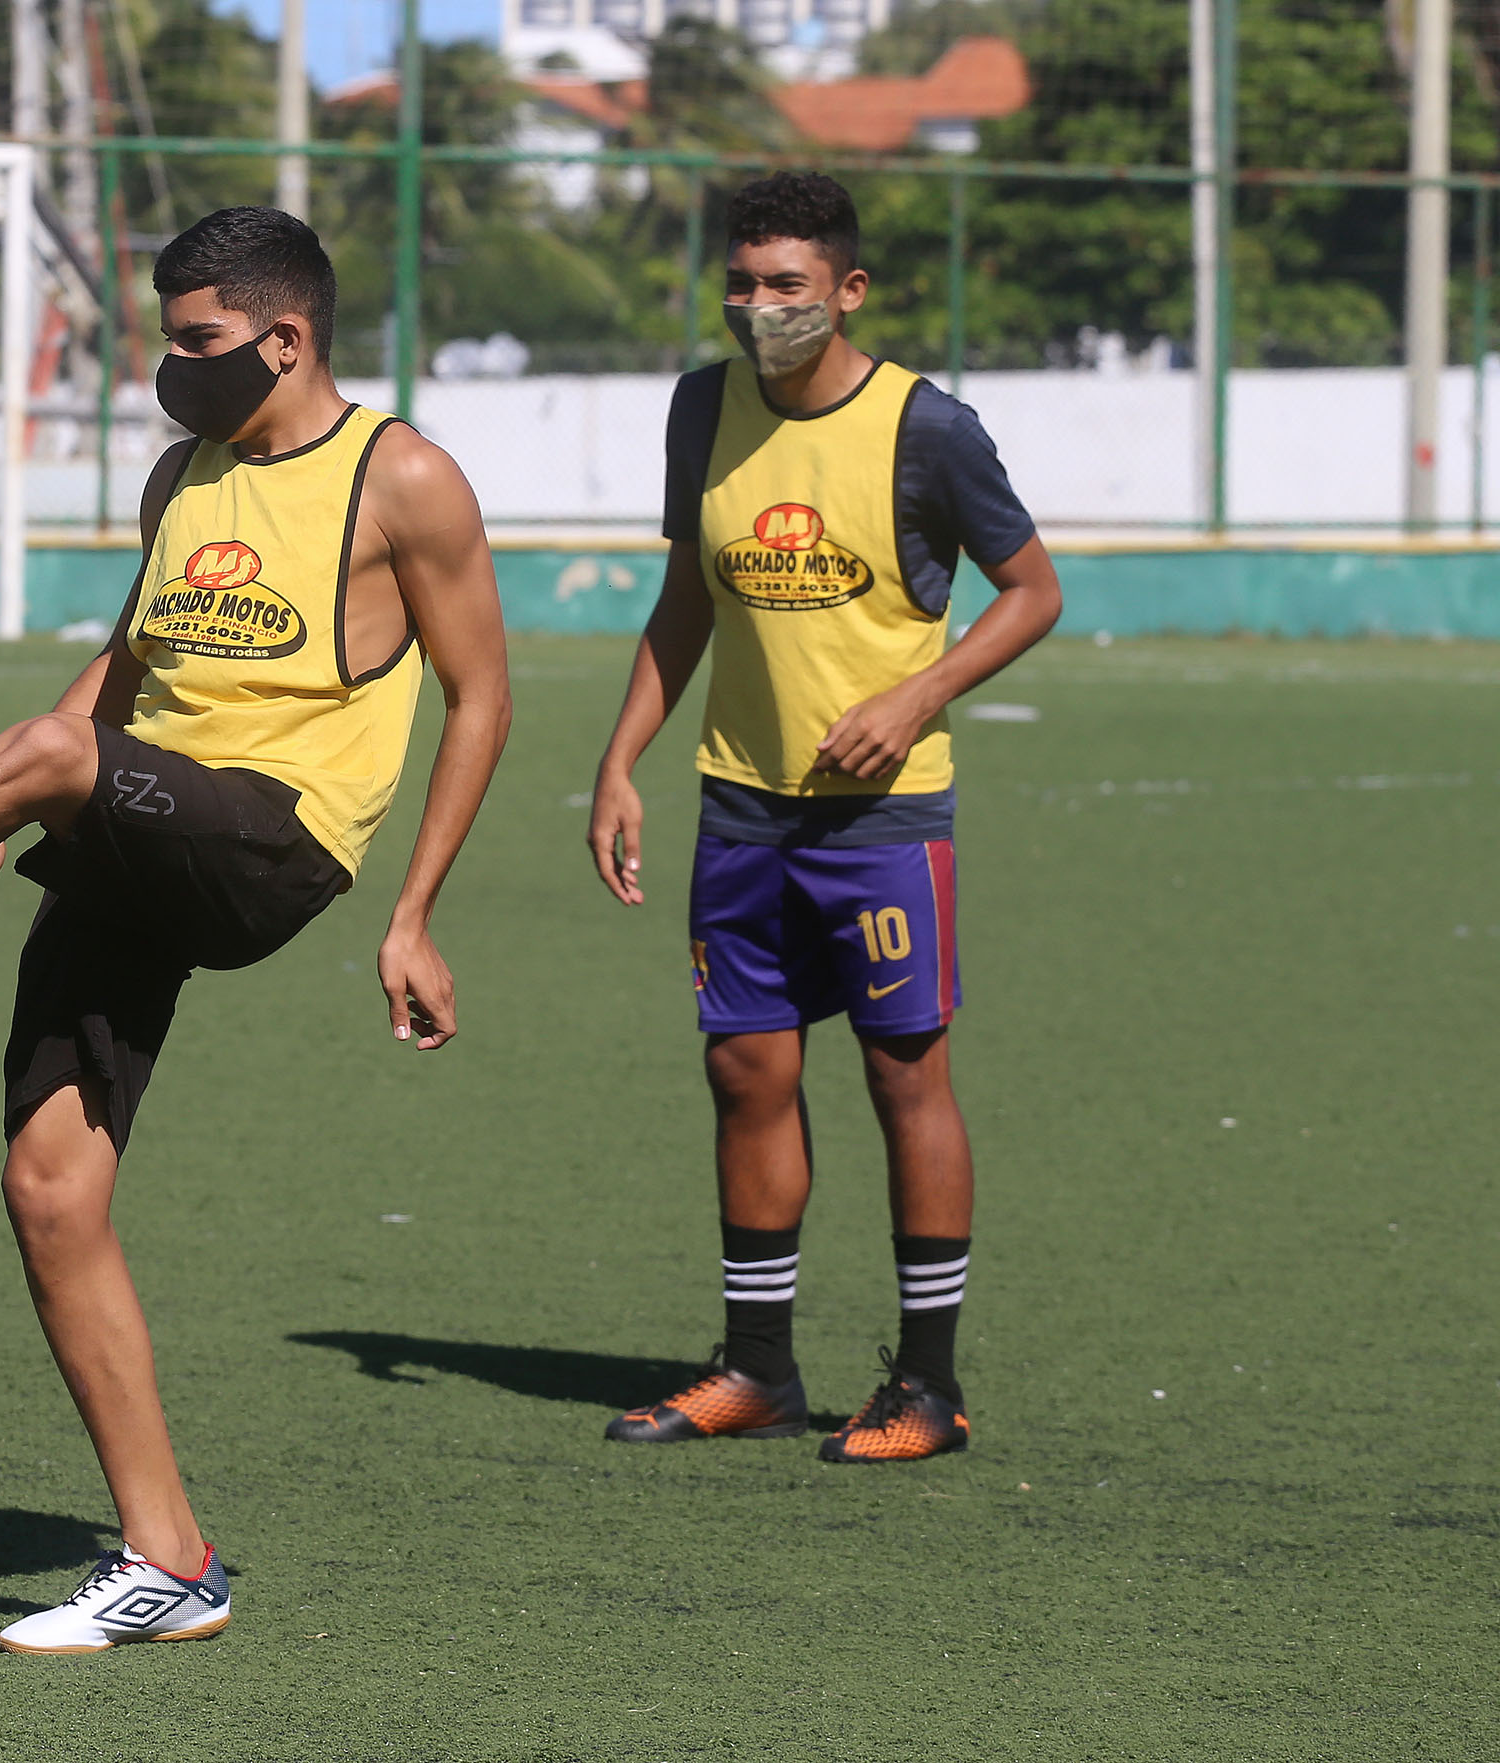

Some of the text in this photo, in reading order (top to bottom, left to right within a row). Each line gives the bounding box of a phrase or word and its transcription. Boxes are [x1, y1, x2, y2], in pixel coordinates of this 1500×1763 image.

[722, 550, 859, 579] MACHADO MOTOS
[215, 592, 292, 634] MOTOS
[163, 621, 256, 645] 3281.6052
[171, 631, 217, 643] Desde 1996
[178, 614, 209, 623] VENDO
[211, 617, 220, 625] E
[221, 618, 278, 640] FINANCIO
[194, 643, 227, 656] duas
[229, 648, 270, 657] rodas
[857, 906, 912, 963] 10
